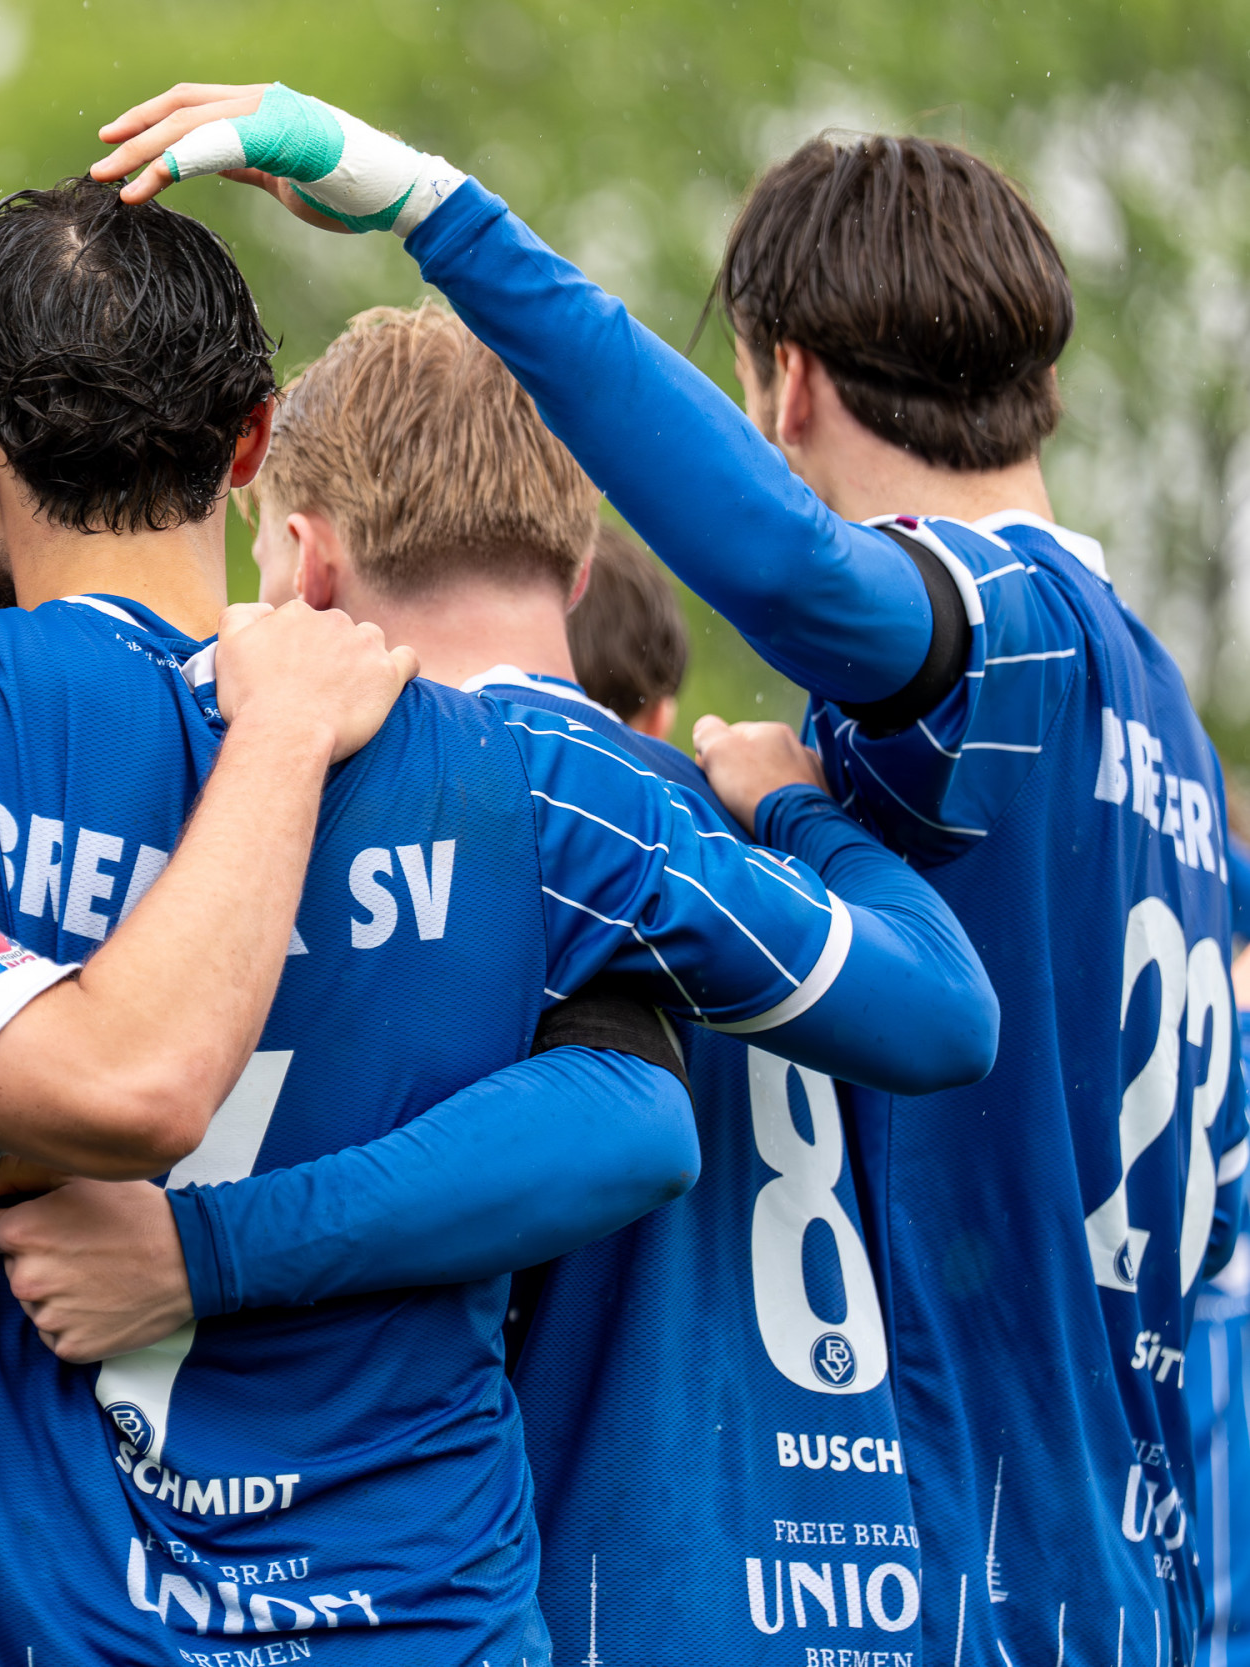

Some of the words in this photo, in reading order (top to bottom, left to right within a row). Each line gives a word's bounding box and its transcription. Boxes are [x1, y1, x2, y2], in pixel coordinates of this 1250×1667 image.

[348, 839, 456, 949] SV
[1085, 896, 1232, 1297] 23
[748, 1045, 888, 1395] 8
[115, 1441, 300, 1516] SCHMIDT
[776, 1432, 903, 1475] BUSCH
[219, 1557, 310, 1585] BRAU
[773, 1519, 846, 1544] FREIE
[853, 1523, 920, 1549] BRAU
[746, 1557, 922, 1634] UNIO
